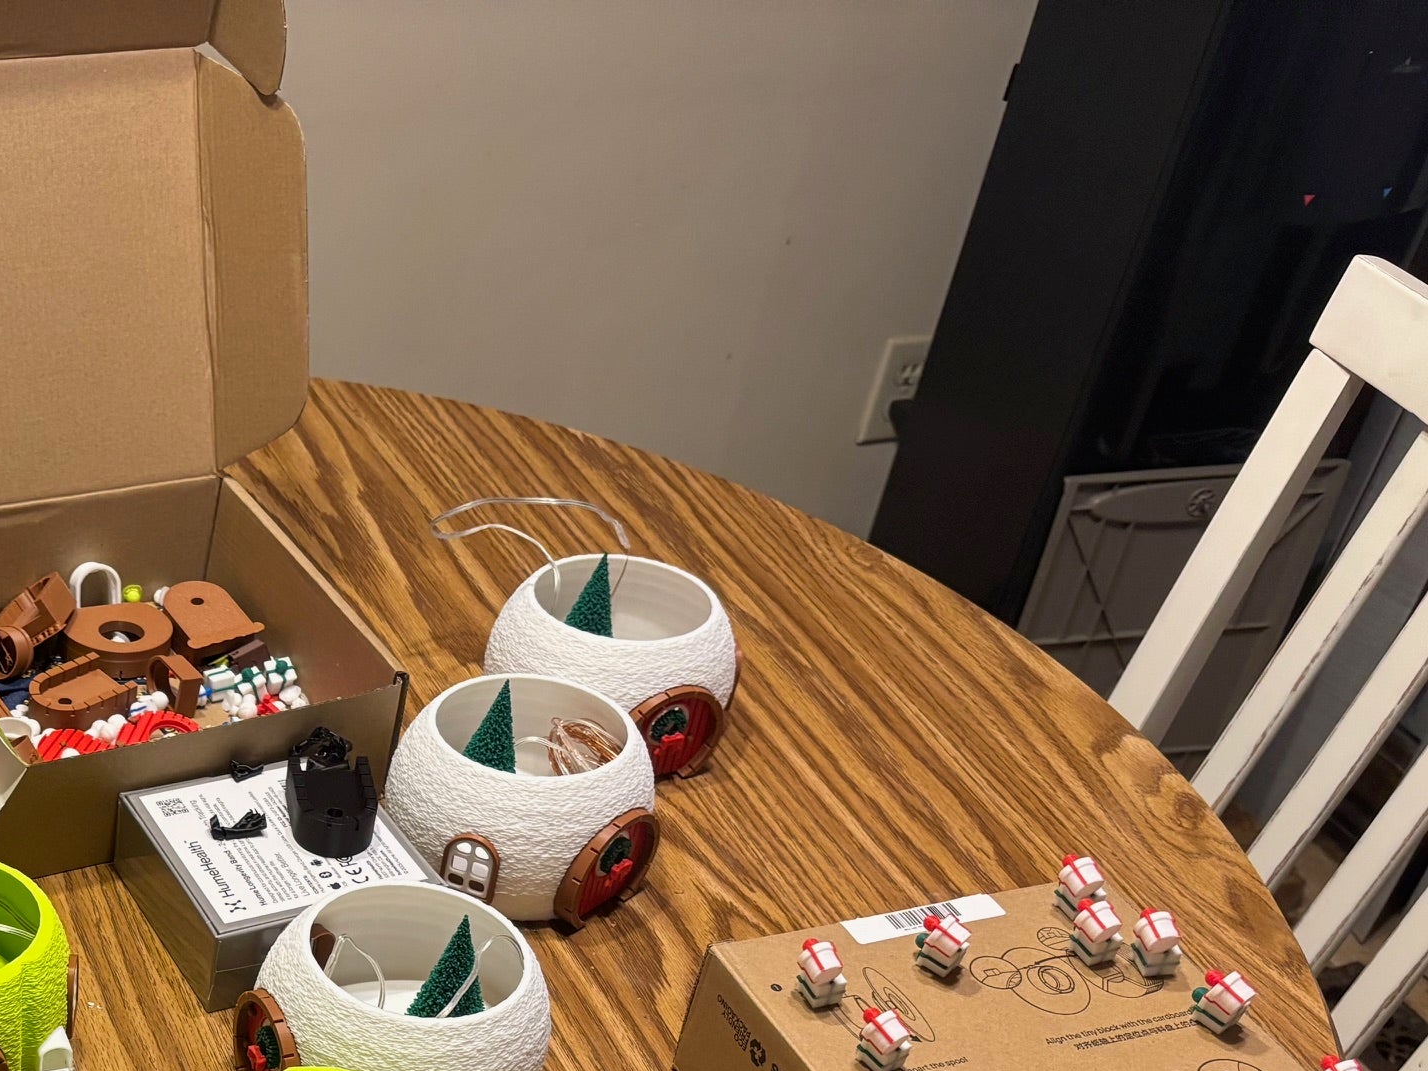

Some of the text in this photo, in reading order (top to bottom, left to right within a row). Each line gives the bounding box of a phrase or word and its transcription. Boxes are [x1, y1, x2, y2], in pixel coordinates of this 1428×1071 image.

[223, 849, 238, 864] Band
[189, 840, 235, 898] HumeHealth
[233, 863, 257, 890] Longevity
[251, 889, 268, 906] Hume
[1045, 1036, 1067, 1045] Align
[1067, 1032, 1082, 1040] the
[1082, 1028, 1098, 1038] tiny
[1097, 1024, 1118, 1034] block
[1119, 1021, 1136, 1030] with
[1137, 1018, 1153, 1027] the
[928, 1061, 944, 1071] the
[943, 1056, 969, 1069] spool
